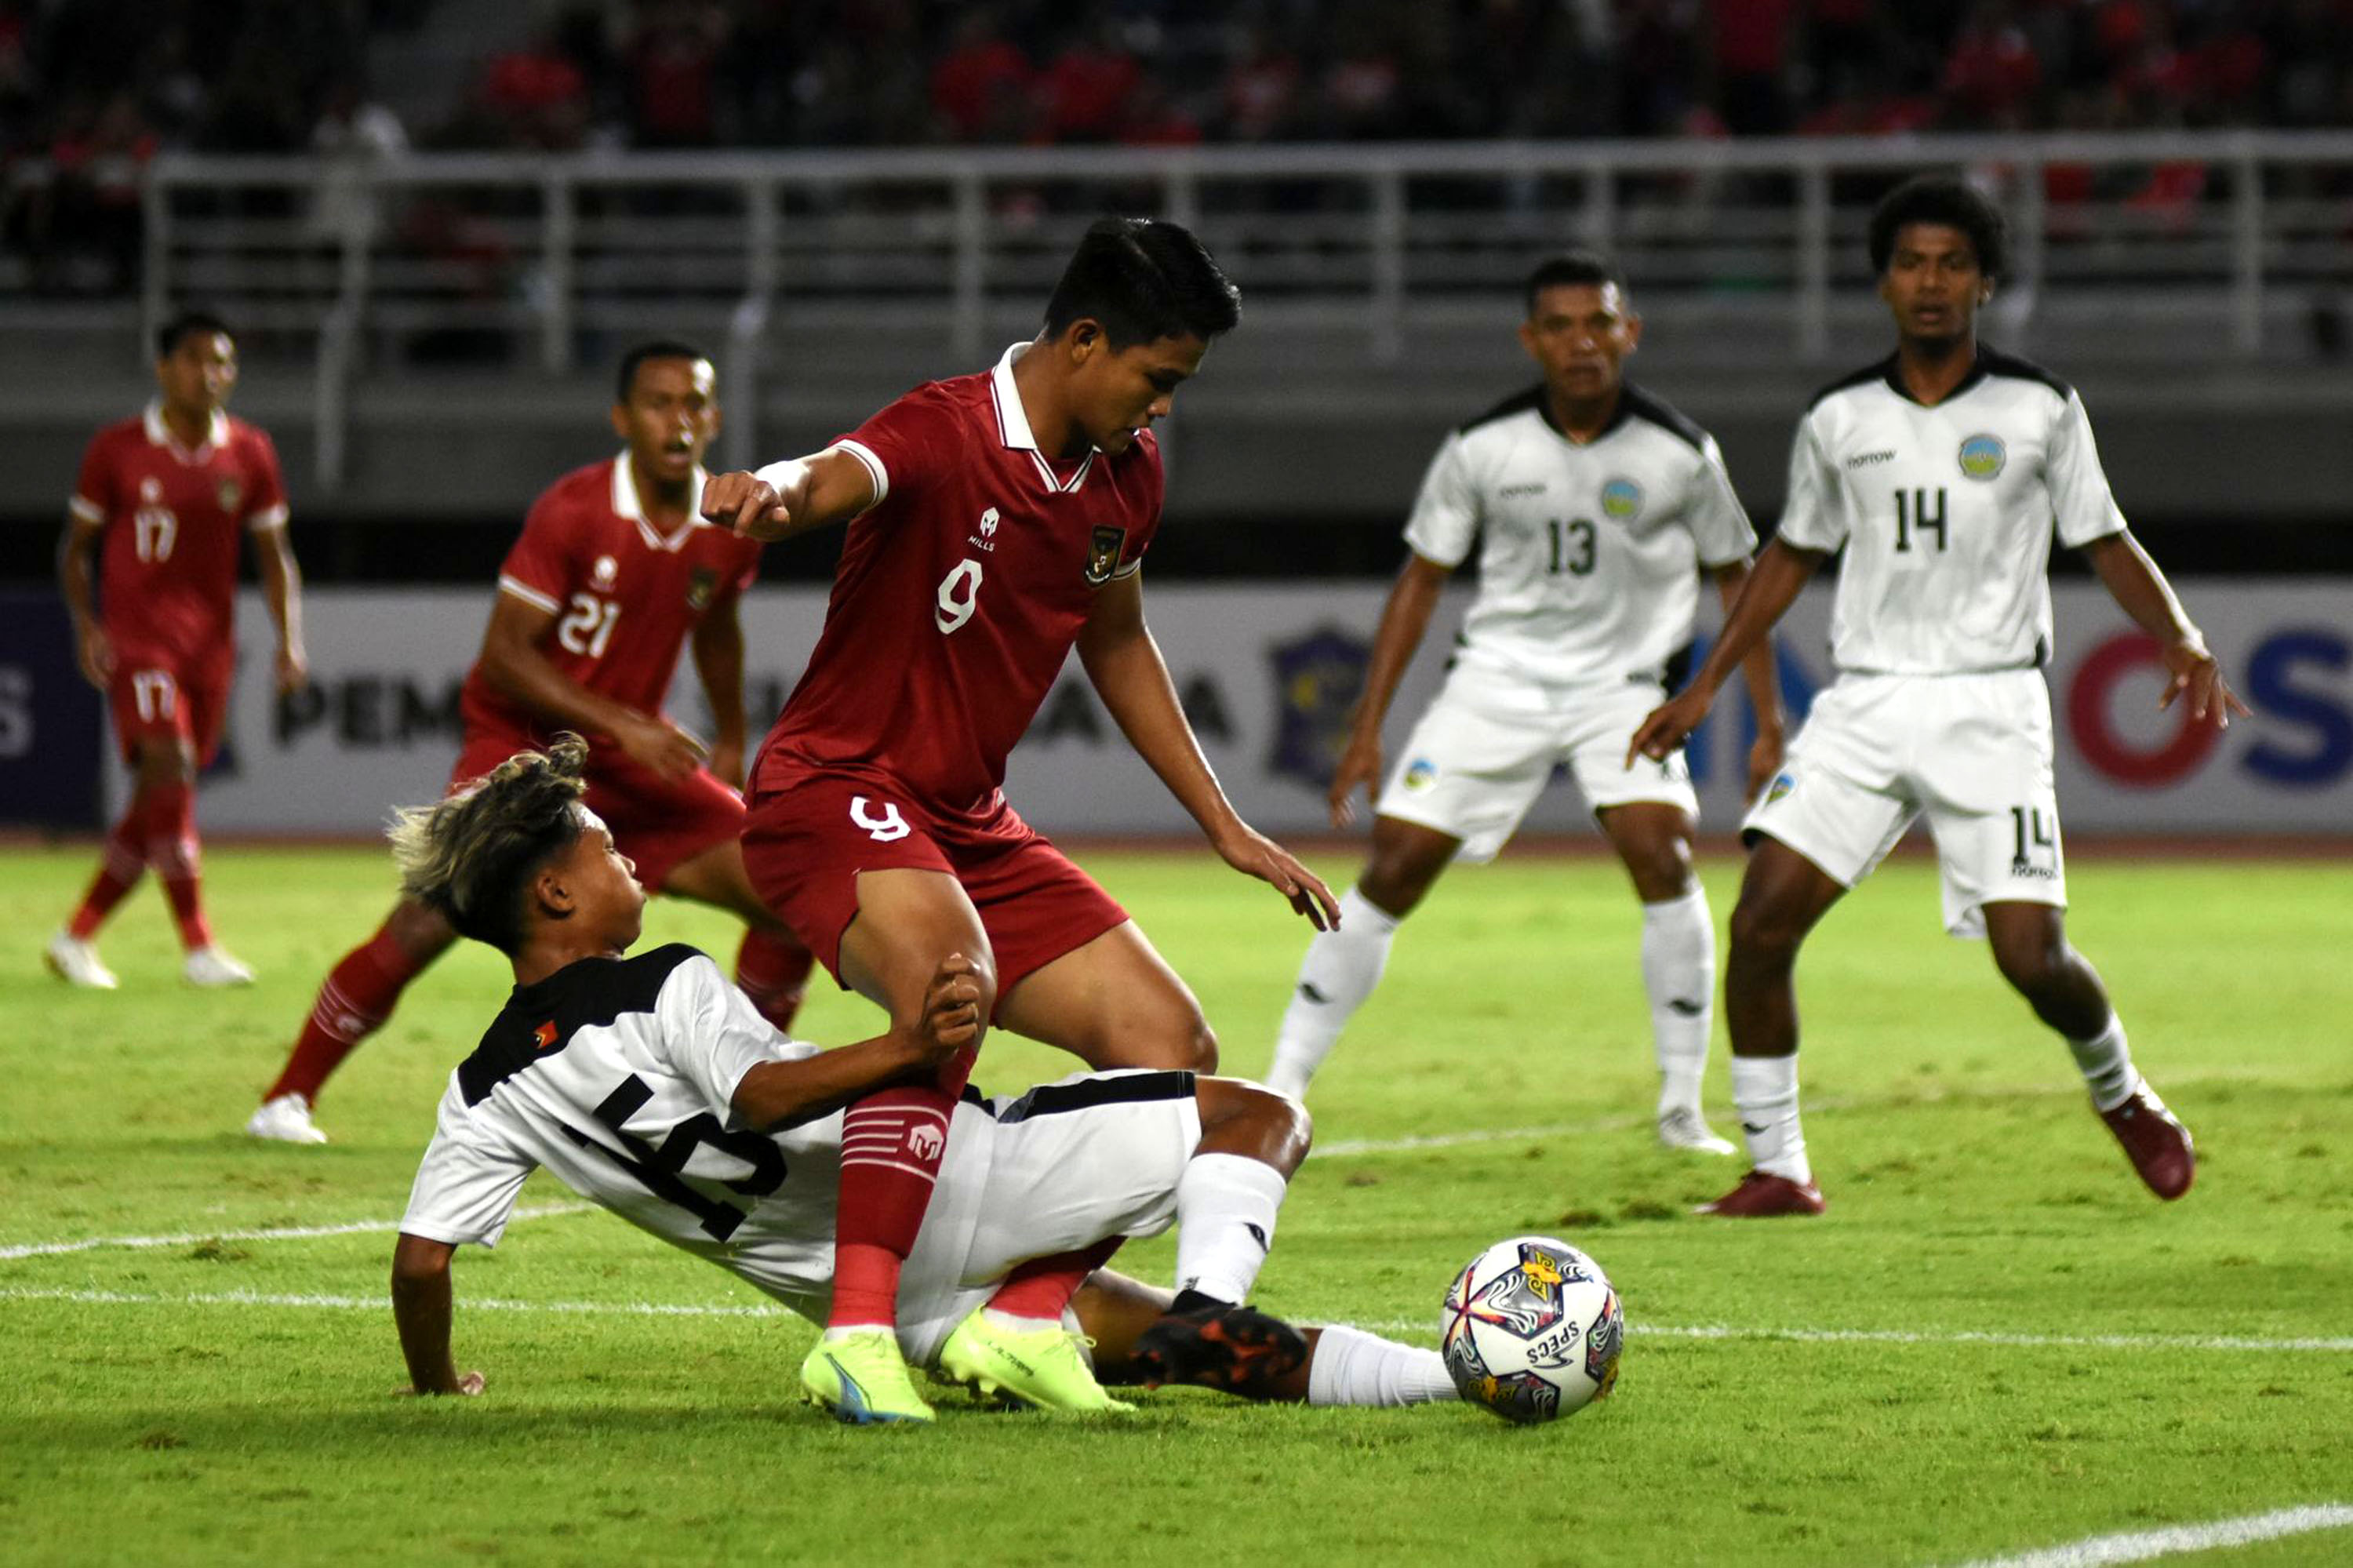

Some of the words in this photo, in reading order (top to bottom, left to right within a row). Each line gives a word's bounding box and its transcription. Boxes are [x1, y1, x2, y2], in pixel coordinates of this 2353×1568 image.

[134, 510, 177, 562] 17
[967, 535, 995, 552] MILLS
[1894, 488, 1948, 551] 14
[1547, 520, 1597, 577] 13
[936, 558, 983, 635] 9
[558, 594, 620, 658] 21
[133, 670, 175, 722] 17
[272, 675, 464, 748] PEM
[849, 796, 911, 842] 9
[2010, 806, 2053, 865] 14
[1526, 1321, 1580, 1364] SPECS
